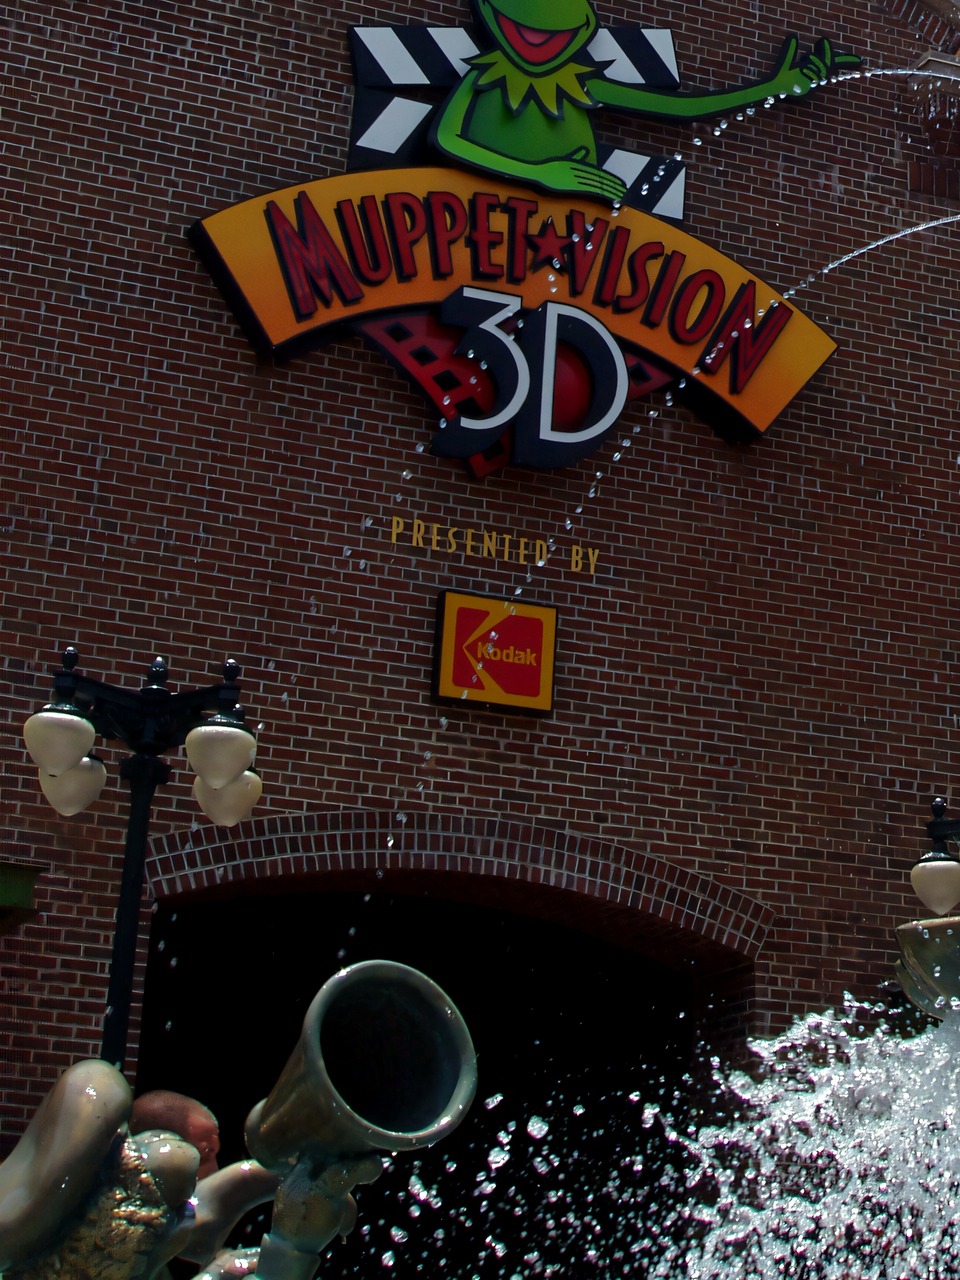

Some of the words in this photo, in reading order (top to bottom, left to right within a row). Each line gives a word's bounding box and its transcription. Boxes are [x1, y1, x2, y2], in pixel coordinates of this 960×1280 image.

[262, 189, 538, 321] MUPPET
[563, 209, 794, 395] VISION
[458, 285, 630, 444] 3D
[391, 515, 548, 566] PRESENTED
[570, 544, 600, 575] BY
[477, 641, 537, 667] Kodak
